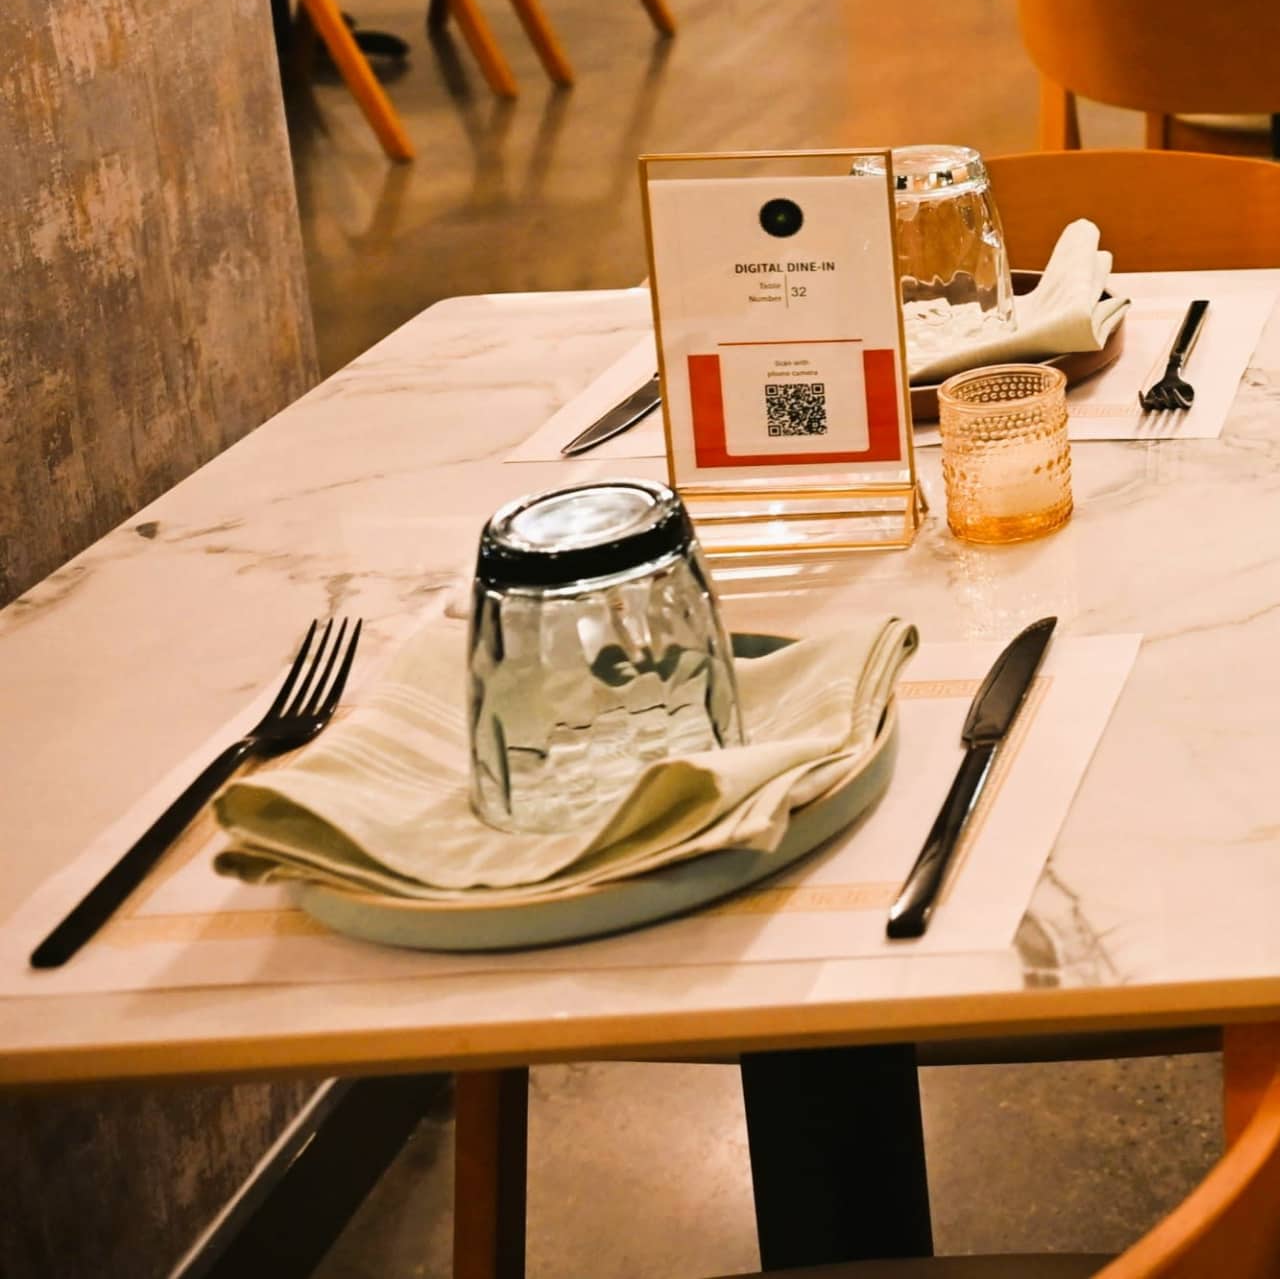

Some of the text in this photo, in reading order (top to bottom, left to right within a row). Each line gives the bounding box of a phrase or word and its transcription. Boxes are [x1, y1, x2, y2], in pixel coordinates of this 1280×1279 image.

[735, 261, 836, 274] DIGITAL DINE-IN
[790, 286, 807, 297] 32
